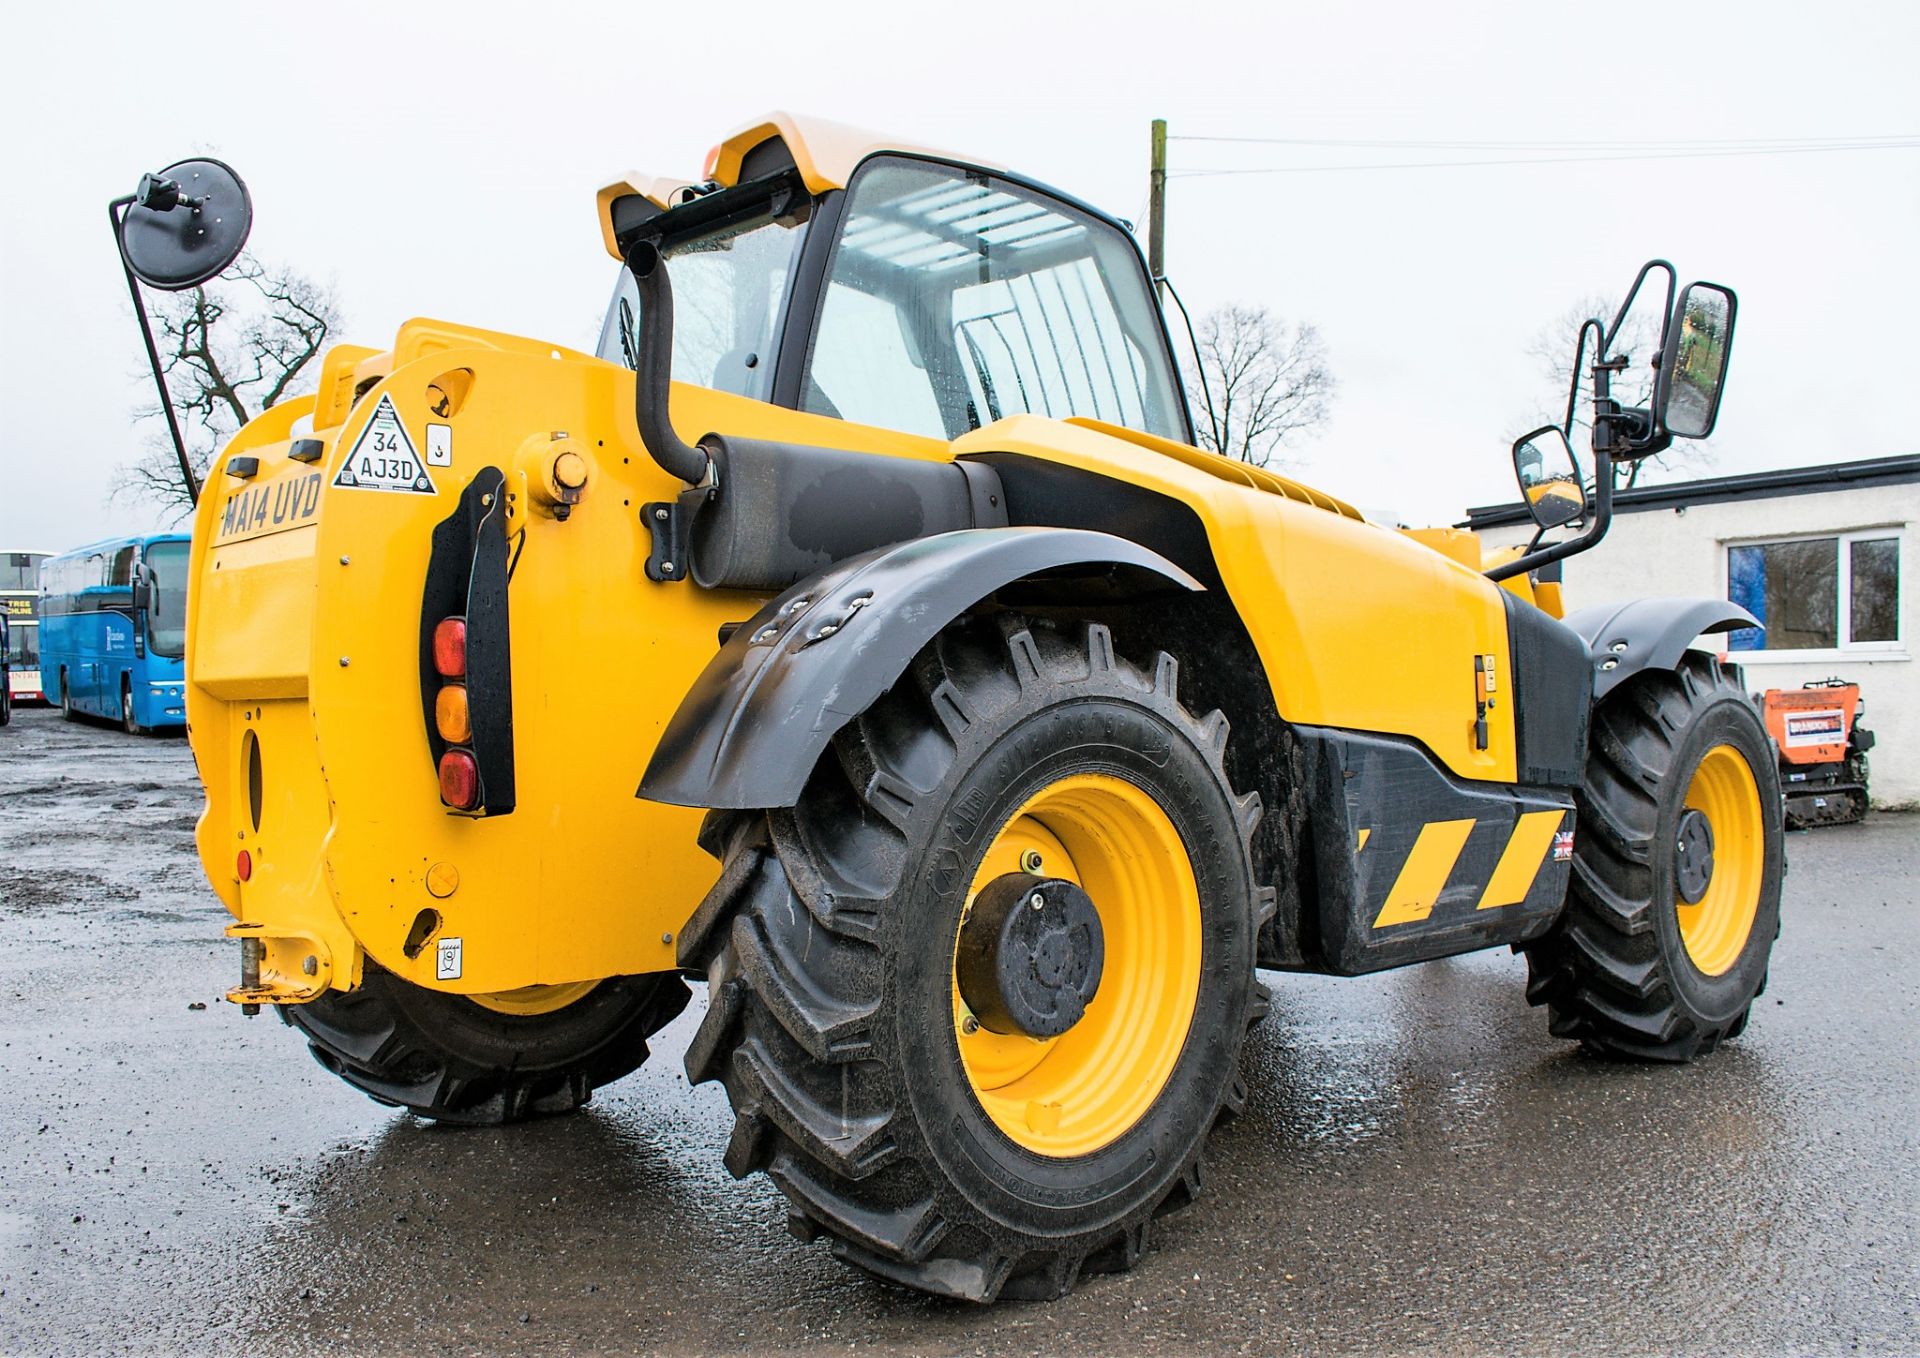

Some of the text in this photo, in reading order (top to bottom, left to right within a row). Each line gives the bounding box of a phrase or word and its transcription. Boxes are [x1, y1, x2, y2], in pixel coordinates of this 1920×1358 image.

[374, 432, 397, 452] 34
[361, 457, 413, 480] AJ3D
[222, 473, 322, 536] MA14 UVD
